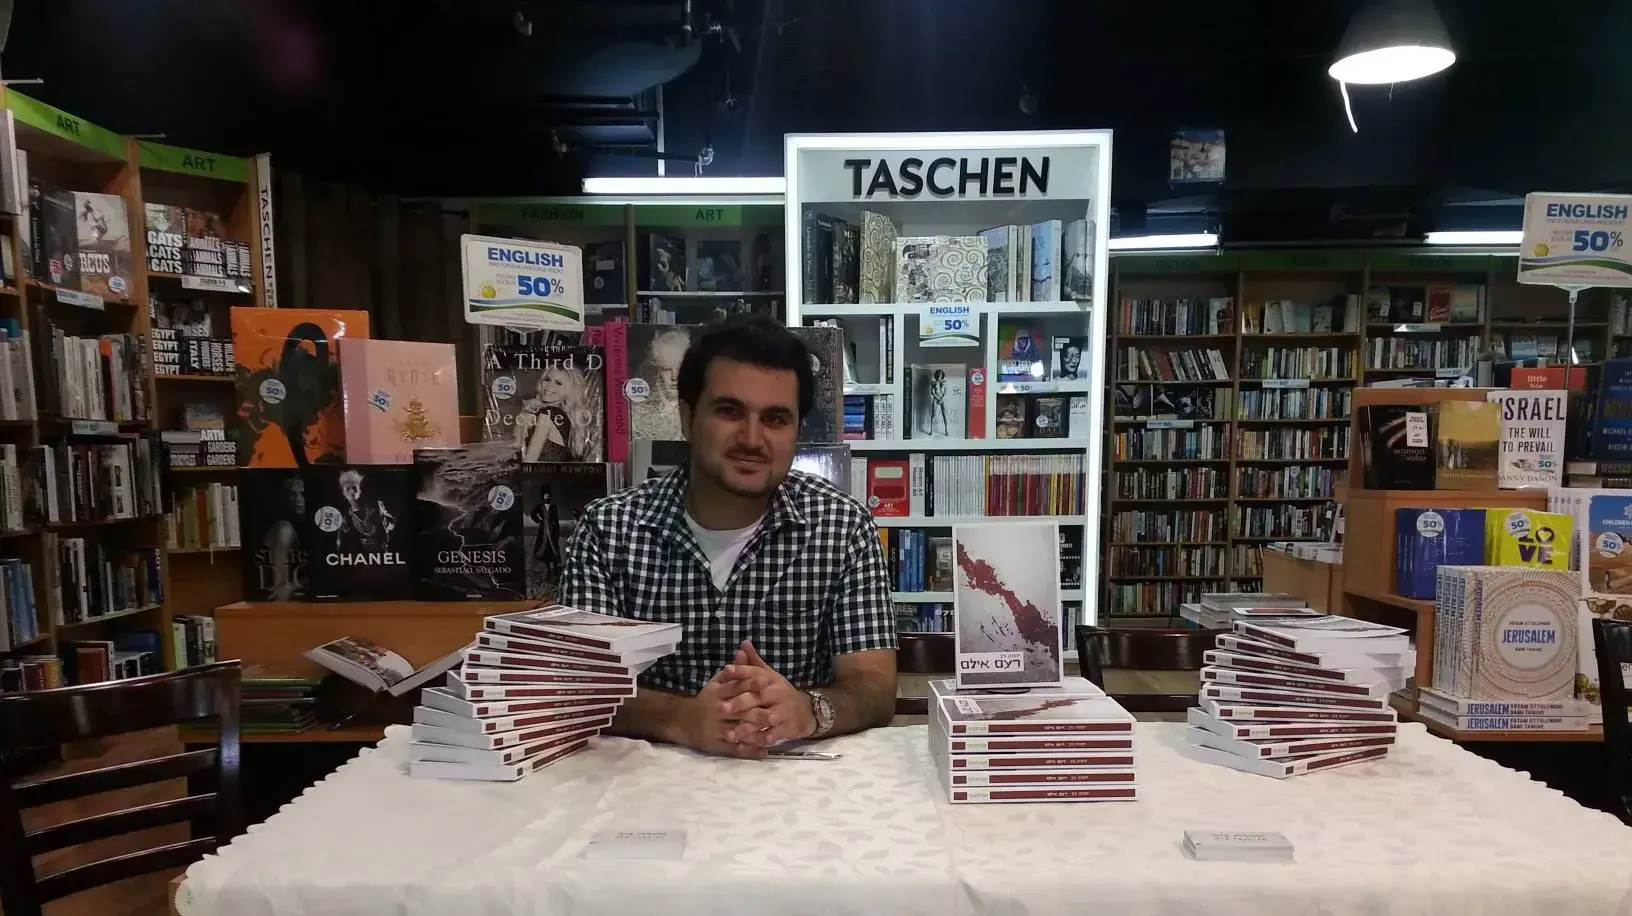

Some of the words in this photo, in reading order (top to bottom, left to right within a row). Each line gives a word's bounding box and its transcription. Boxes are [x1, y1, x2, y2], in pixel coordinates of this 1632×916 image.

[57, 117, 80, 136] ART
[182, 155, 215, 172] ART
[844, 156, 1050, 196] TASCHEN
[696, 208, 724, 220] ART
[1547, 203, 1628, 219] ENGLISH
[147, 230, 183, 248] CATS
[260, 188, 273, 285] TASCHEN
[1572, 230, 1624, 252] 50%
[149, 245, 182, 260] CATS
[487, 247, 564, 268] ENGLISH
[151, 259, 183, 274] CATS
[517, 274, 564, 297] 50%
[930, 306, 970, 314] ENGLISH
[944, 319, 969, 330] 50%
[151, 329, 176, 340] EGYPT
[152, 340, 178, 351] EGYPT
[153, 352, 179, 363] EGYPT
[189, 340, 200, 369] ITALY
[210, 342, 224, 372] HORSES
[223, 343, 235, 372] WILDLIFE
[486, 354, 502, 370] A
[514, 353, 574, 370] Third
[154, 364, 180, 375] EGYPT
[1508, 427, 1526, 439] THE
[1529, 427, 1551, 439] WILL
[207, 441, 237, 453] GARDENS
[1502, 441, 1514, 453] TO
[1518, 441, 1555, 453] PREVAIL
[206, 454, 236, 466] GARDENS
[325, 552, 406, 566] CHANEL
[437, 550, 506, 564] GENESIS
[475, 566, 512, 574] SALGADO
[1502, 629, 1556, 644] JERUSALEM
[960, 658, 990, 670] אילם
[994, 659, 1021, 669] רעם
[1467, 703, 1509, 715] JERUSALEM
[1467, 718, 1509, 729] JERUSALEM
